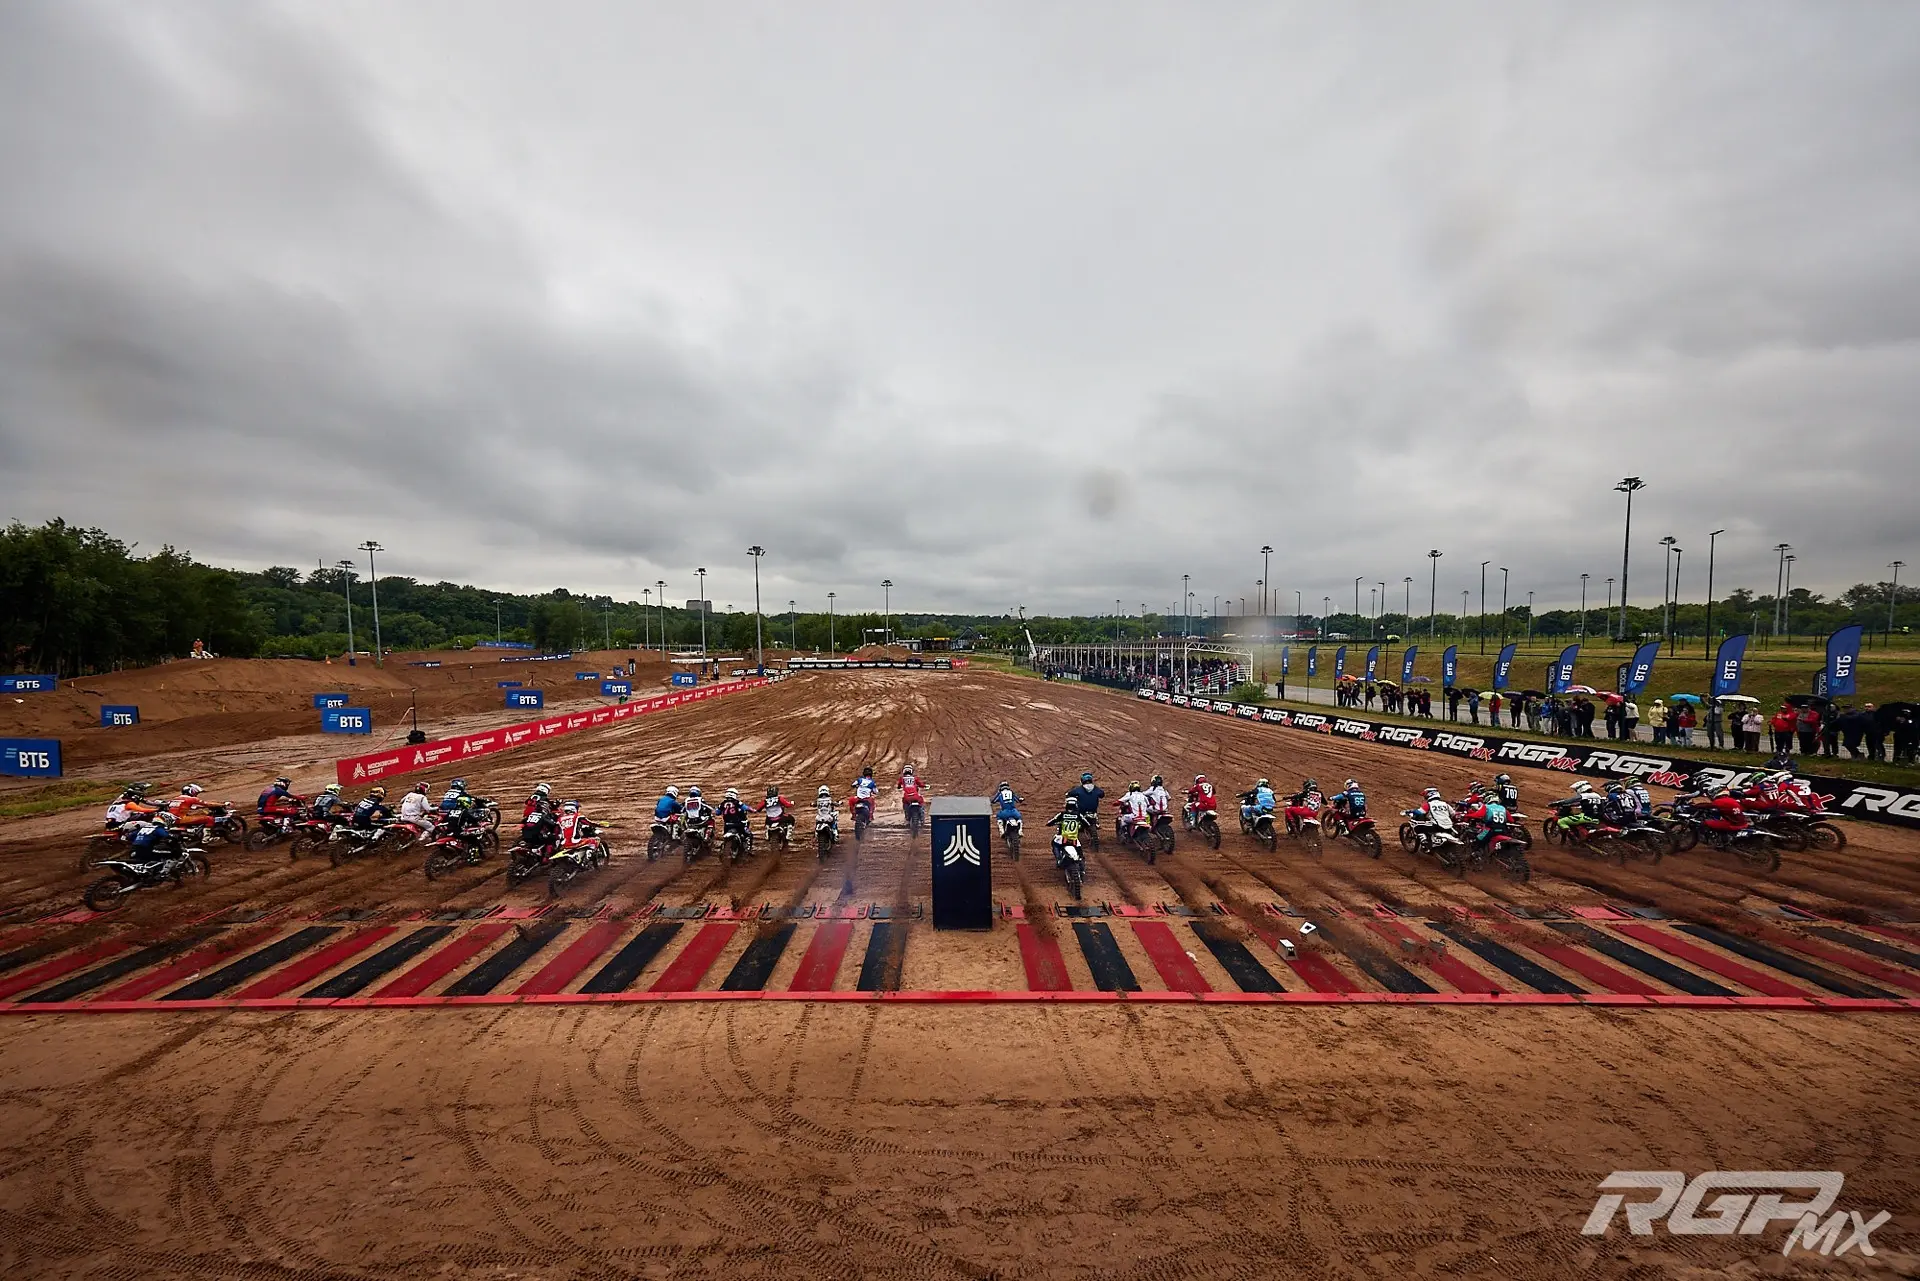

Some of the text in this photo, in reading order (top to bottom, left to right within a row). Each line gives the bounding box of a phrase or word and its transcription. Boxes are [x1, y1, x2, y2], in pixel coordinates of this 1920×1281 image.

[1500, 662, 1510, 676] ВТБ
[1723, 660, 1738, 680] ВТБ
[1836, 655, 1852, 677] ВТБ
[1561, 664, 1572, 681] ВТБ
[1634, 664, 1649, 682] ВТБ
[16, 681, 40, 689] ВТБ
[519, 696, 537, 705] ВТБ
[1173, 695, 1188, 704] RGP
[1191, 698, 1210, 708] RGP
[1213, 702, 1232, 712] RGP
[1237, 705, 1258, 716] RGP
[113, 714, 133, 725] ВТБ
[1262, 709, 1288, 720] RGP
[1294, 713, 1326, 727] RGP
[340, 717, 363, 727] ВТБ
[1334, 719, 1371, 735] RGP
[1379, 727, 1432, 749] RGP MX
[1433, 733, 1495, 761] RGP MX
[19, 752, 50, 768] ВТБ
[1498, 742, 1580, 771] RGP MX
[1583, 752, 1689, 790] RGP MX
[1505, 788, 1517, 799] 707
[1354, 797, 1365, 806] 65
[1493, 813, 1505, 823] 55
[1064, 820, 1077, 832] 70
